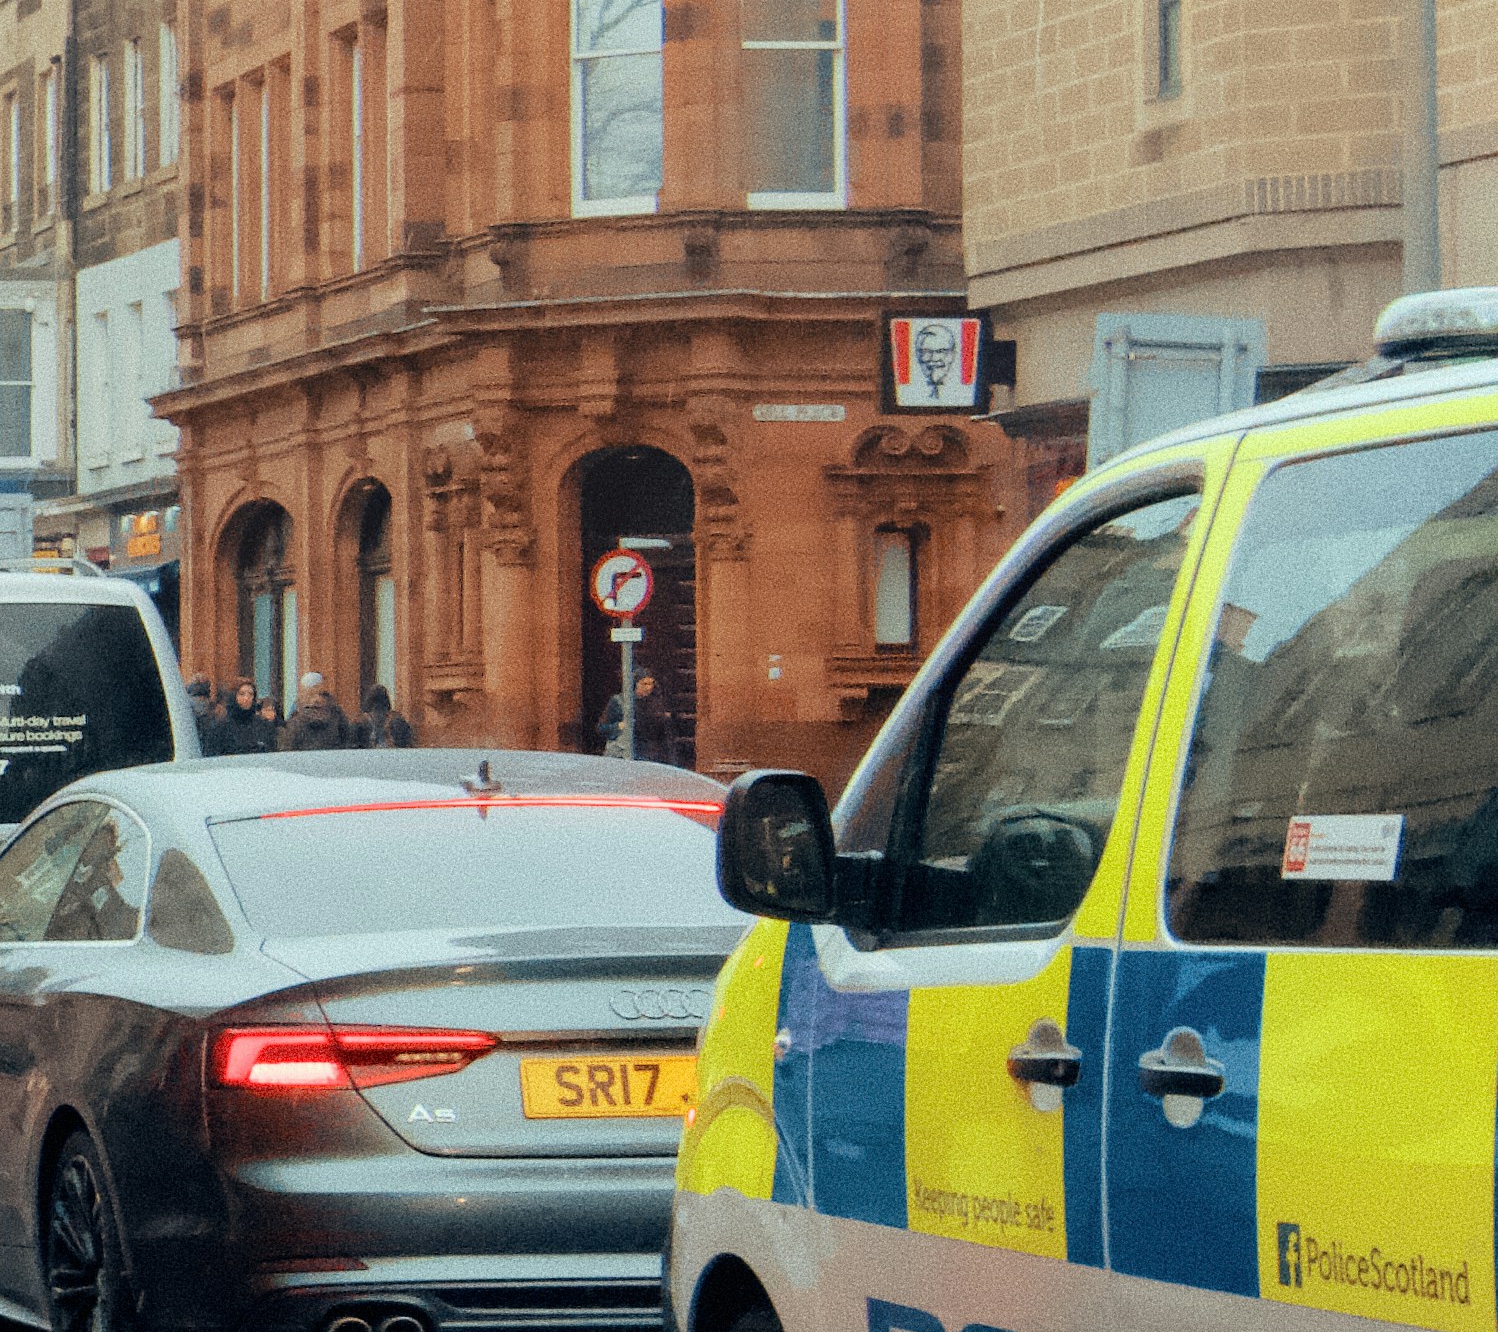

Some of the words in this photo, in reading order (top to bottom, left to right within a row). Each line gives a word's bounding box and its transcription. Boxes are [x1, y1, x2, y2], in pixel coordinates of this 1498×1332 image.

[52, 713, 87, 726] travel
[26, 729, 83, 743] bookings
[556, 1063, 661, 1108] SR17
[407, 1103, 456, 1123] A5
[912, 1177, 971, 1226] Keeping
[972, 1190, 1023, 1233] people
[1024, 1199, 1056, 1234] safe
[1305, 1236, 1472, 1307] PoliceScotland
